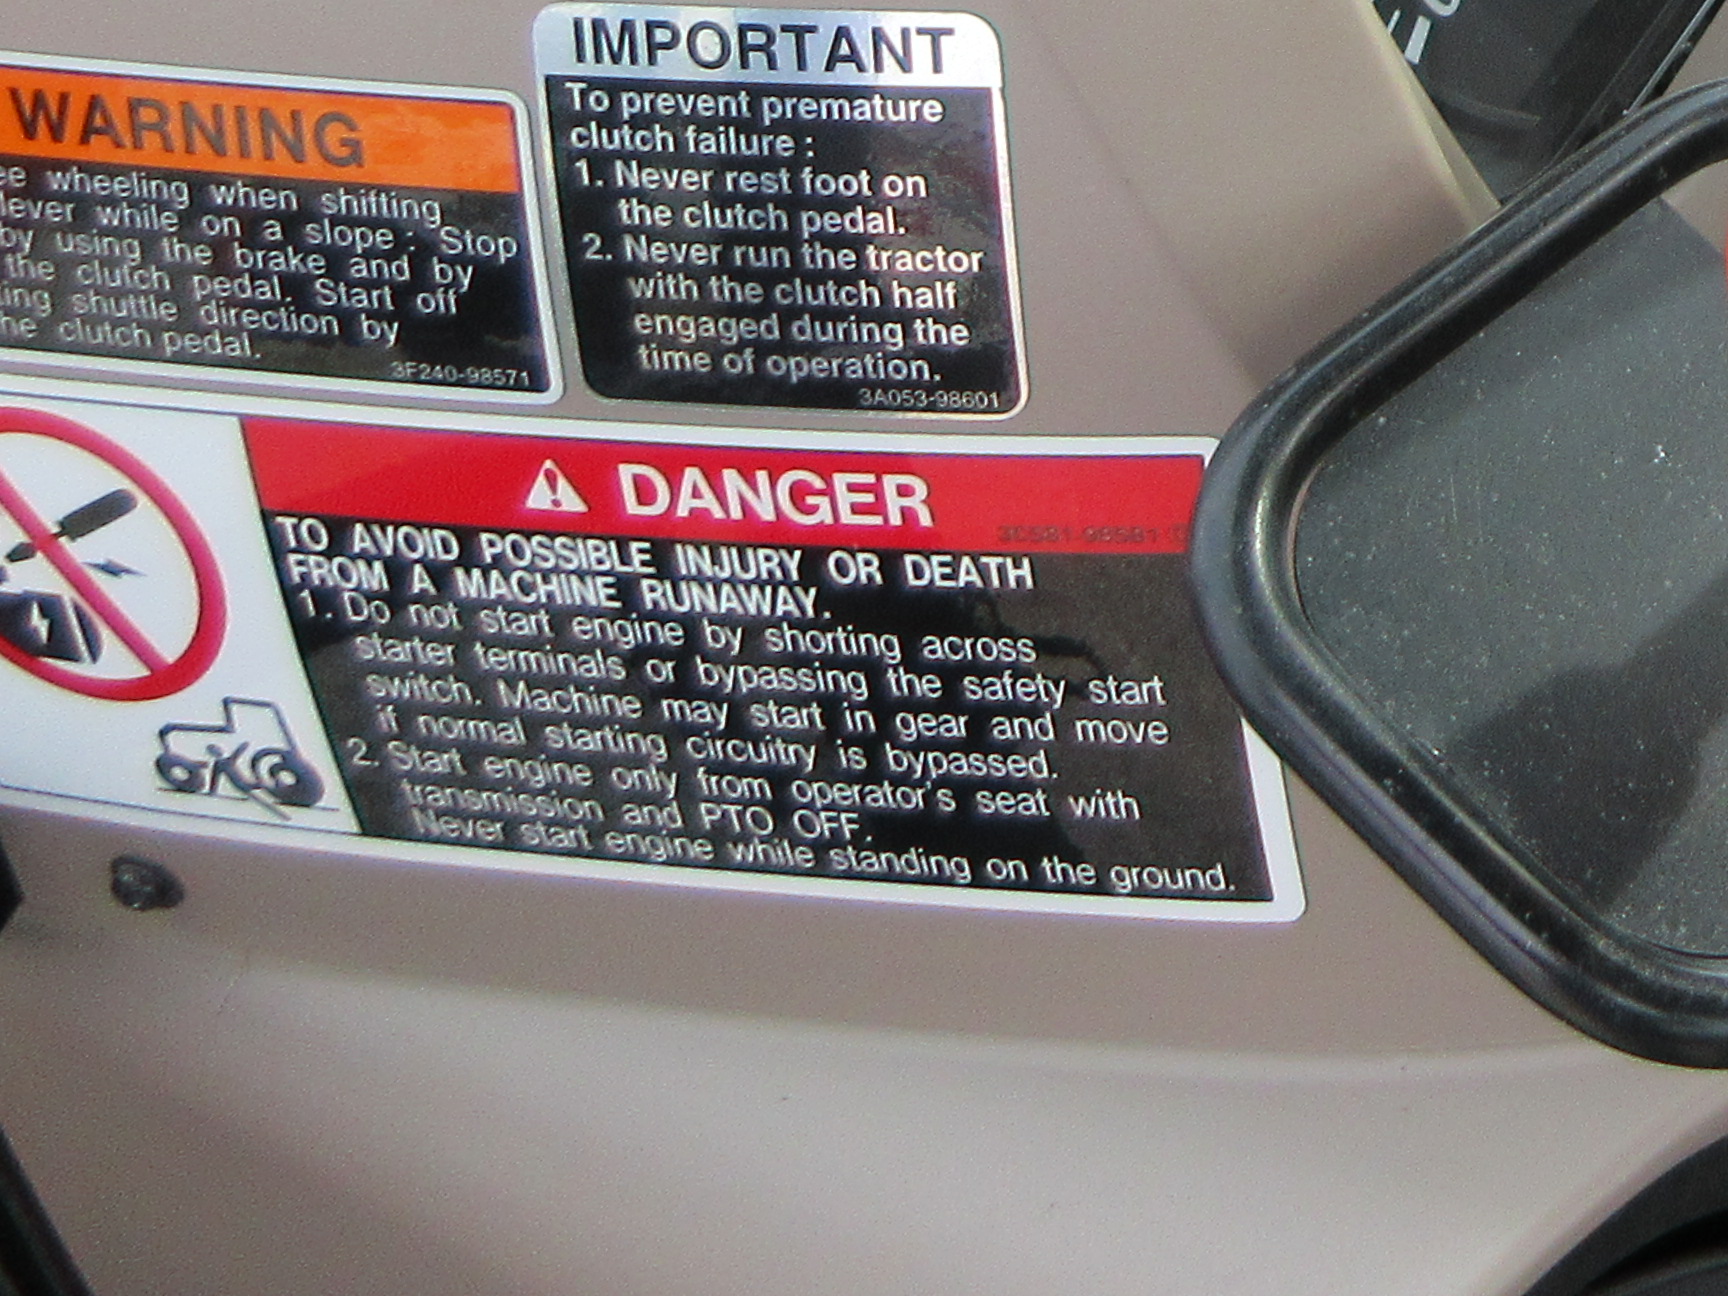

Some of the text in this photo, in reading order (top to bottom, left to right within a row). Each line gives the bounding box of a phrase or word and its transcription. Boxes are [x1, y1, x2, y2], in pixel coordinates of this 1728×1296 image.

[572, 17, 955, 75] IMPORTANT
[8, 86, 364, 168] WARNING
[565, 82, 945, 127] To prevent premature
[570, 121, 675, 154] clutch
[48, 165, 190, 209] wheeling
[210, 180, 298, 212] when
[320, 187, 442, 228] shifting
[574, 158, 927, 199] 1. Never rest foot on
[0, 190, 75, 223] lever
[96, 201, 180, 232] while
[201, 215, 241, 237] on
[263, 220, 283, 242] a
[440, 226, 518, 263] Stop
[618, 198, 907, 238] the clutch pedal.
[6, 253, 458, 315] the clutch pedal. Start off
[56, 229, 141, 265] using
[161, 237, 213, 265] the
[232, 241, 327, 275] brake
[350, 254, 411, 281] and
[433, 257, 473, 293] by
[582, 233, 984, 273] 2. Never run the tractor
[71, 289, 179, 322] shuttle
[200, 298, 340, 335] direction
[360, 313, 398, 348] by
[629, 270, 957, 309] with the clutch half
[59, 318, 261, 358] clutch pedal.
[633, 313, 970, 351] engaged during the
[390, 361, 531, 387] 3F240-98571
[638, 343, 941, 384] time of operation.
[860, 388, 999, 408] 3A053-98601
[618, 462, 933, 527] DANGER
[276, 515, 1034, 590] TO AVOID POSSIBLE INJURY OR DEATH
[286, 554, 832, 620] FROM A MACHINE RUNAWAY.
[342, 591, 391, 625] Do
[407, 600, 462, 631] not
[480, 606, 554, 638] start
[571, 612, 685, 650] engine
[703, 618, 744, 656] by
[763, 622, 902, 662] shorting
[921, 635, 1038, 663] across
[354, 632, 1168, 708] starter terminals or bypassing the safety start
[365, 671, 1170, 745] switch. Machine may start in gear and move
[375, 704, 1058, 779] if normal starting circuitry is bypassed.
[346, 738, 1143, 821] 2. Start engine only from operator's seat with
[401, 779, 873, 843] transmission and PTO OFF.
[409, 809, 1235, 893] Never start engine while standing on the ground.
